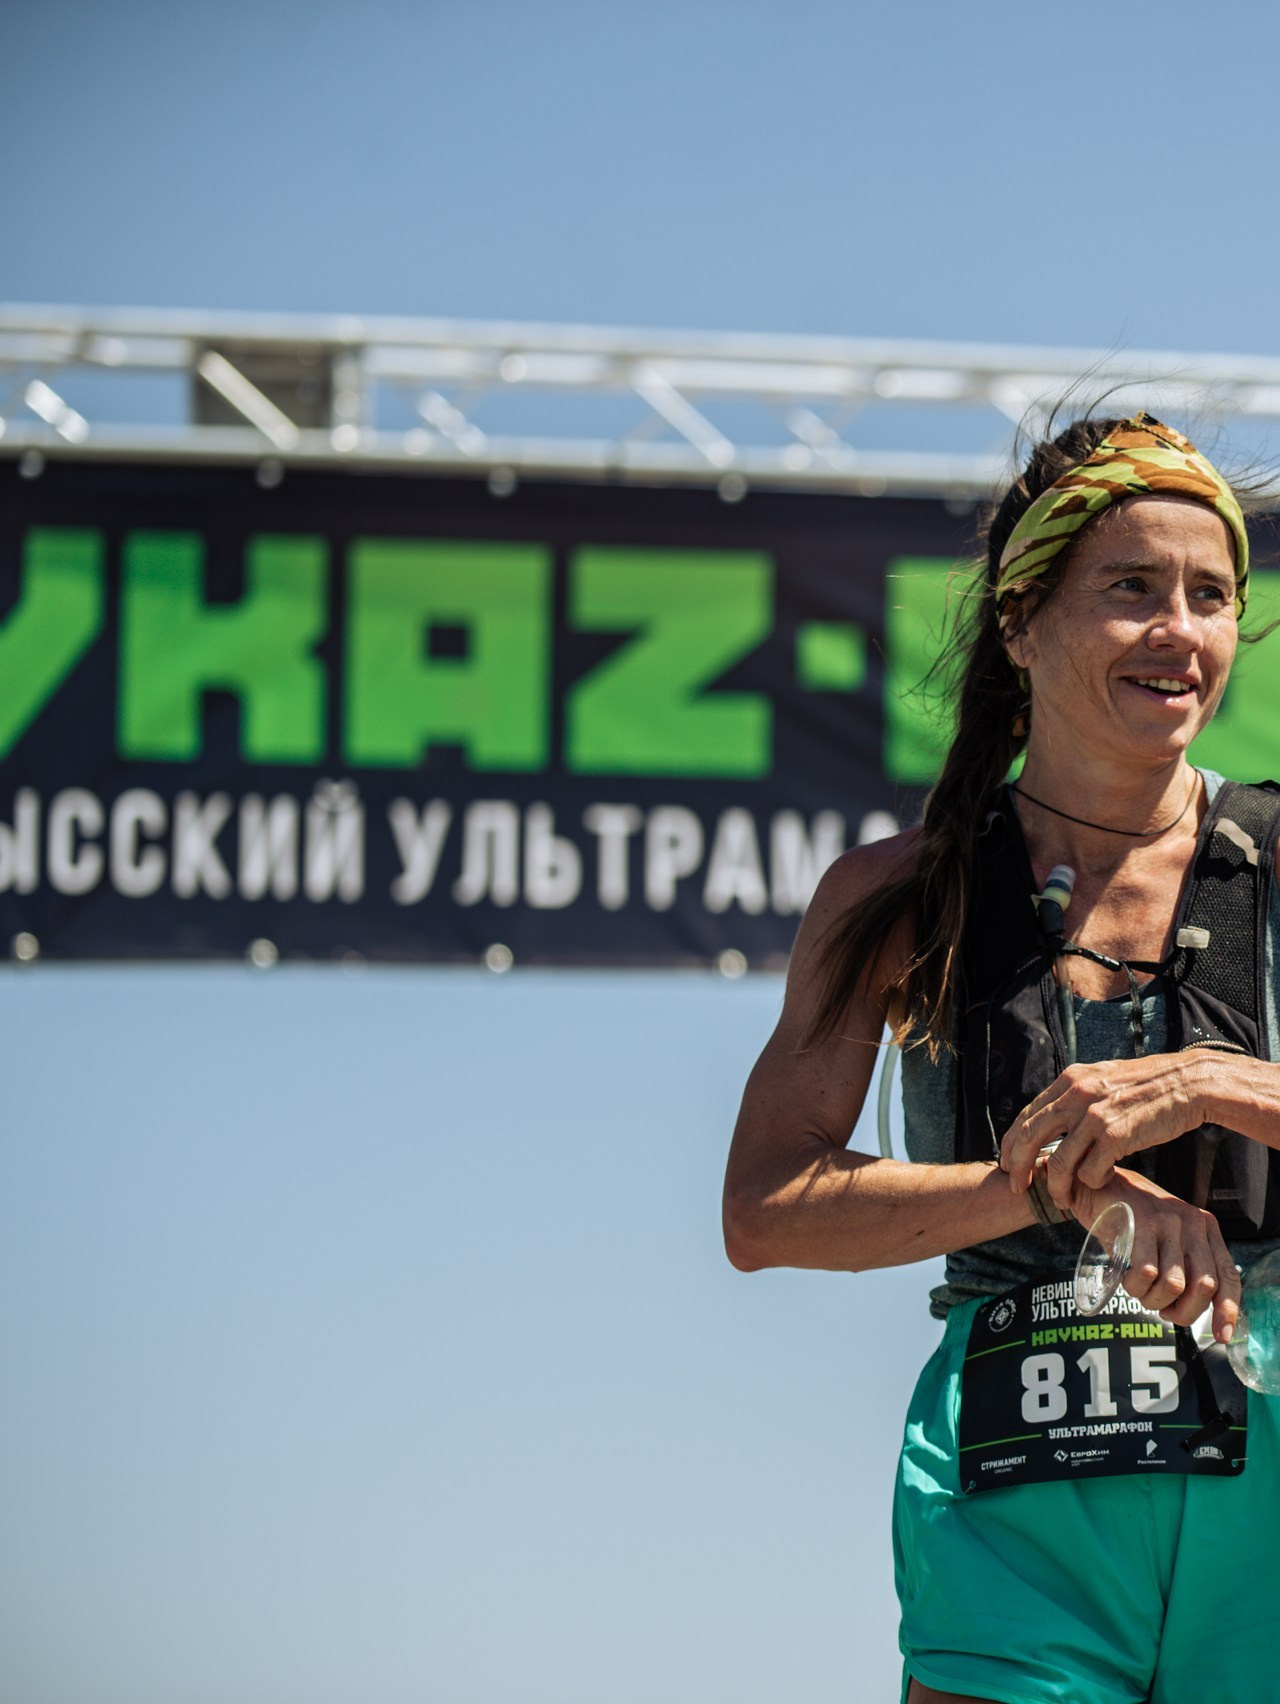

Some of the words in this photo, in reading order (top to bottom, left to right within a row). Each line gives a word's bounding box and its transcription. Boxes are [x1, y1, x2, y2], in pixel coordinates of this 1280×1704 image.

[1021, 1345, 1180, 1424] 815
[1048, 1421, 1153, 1440] УЛЬТРАМАРАФОН
[981, 1455, 1027, 1471] СТРИЖАМЕНТ
